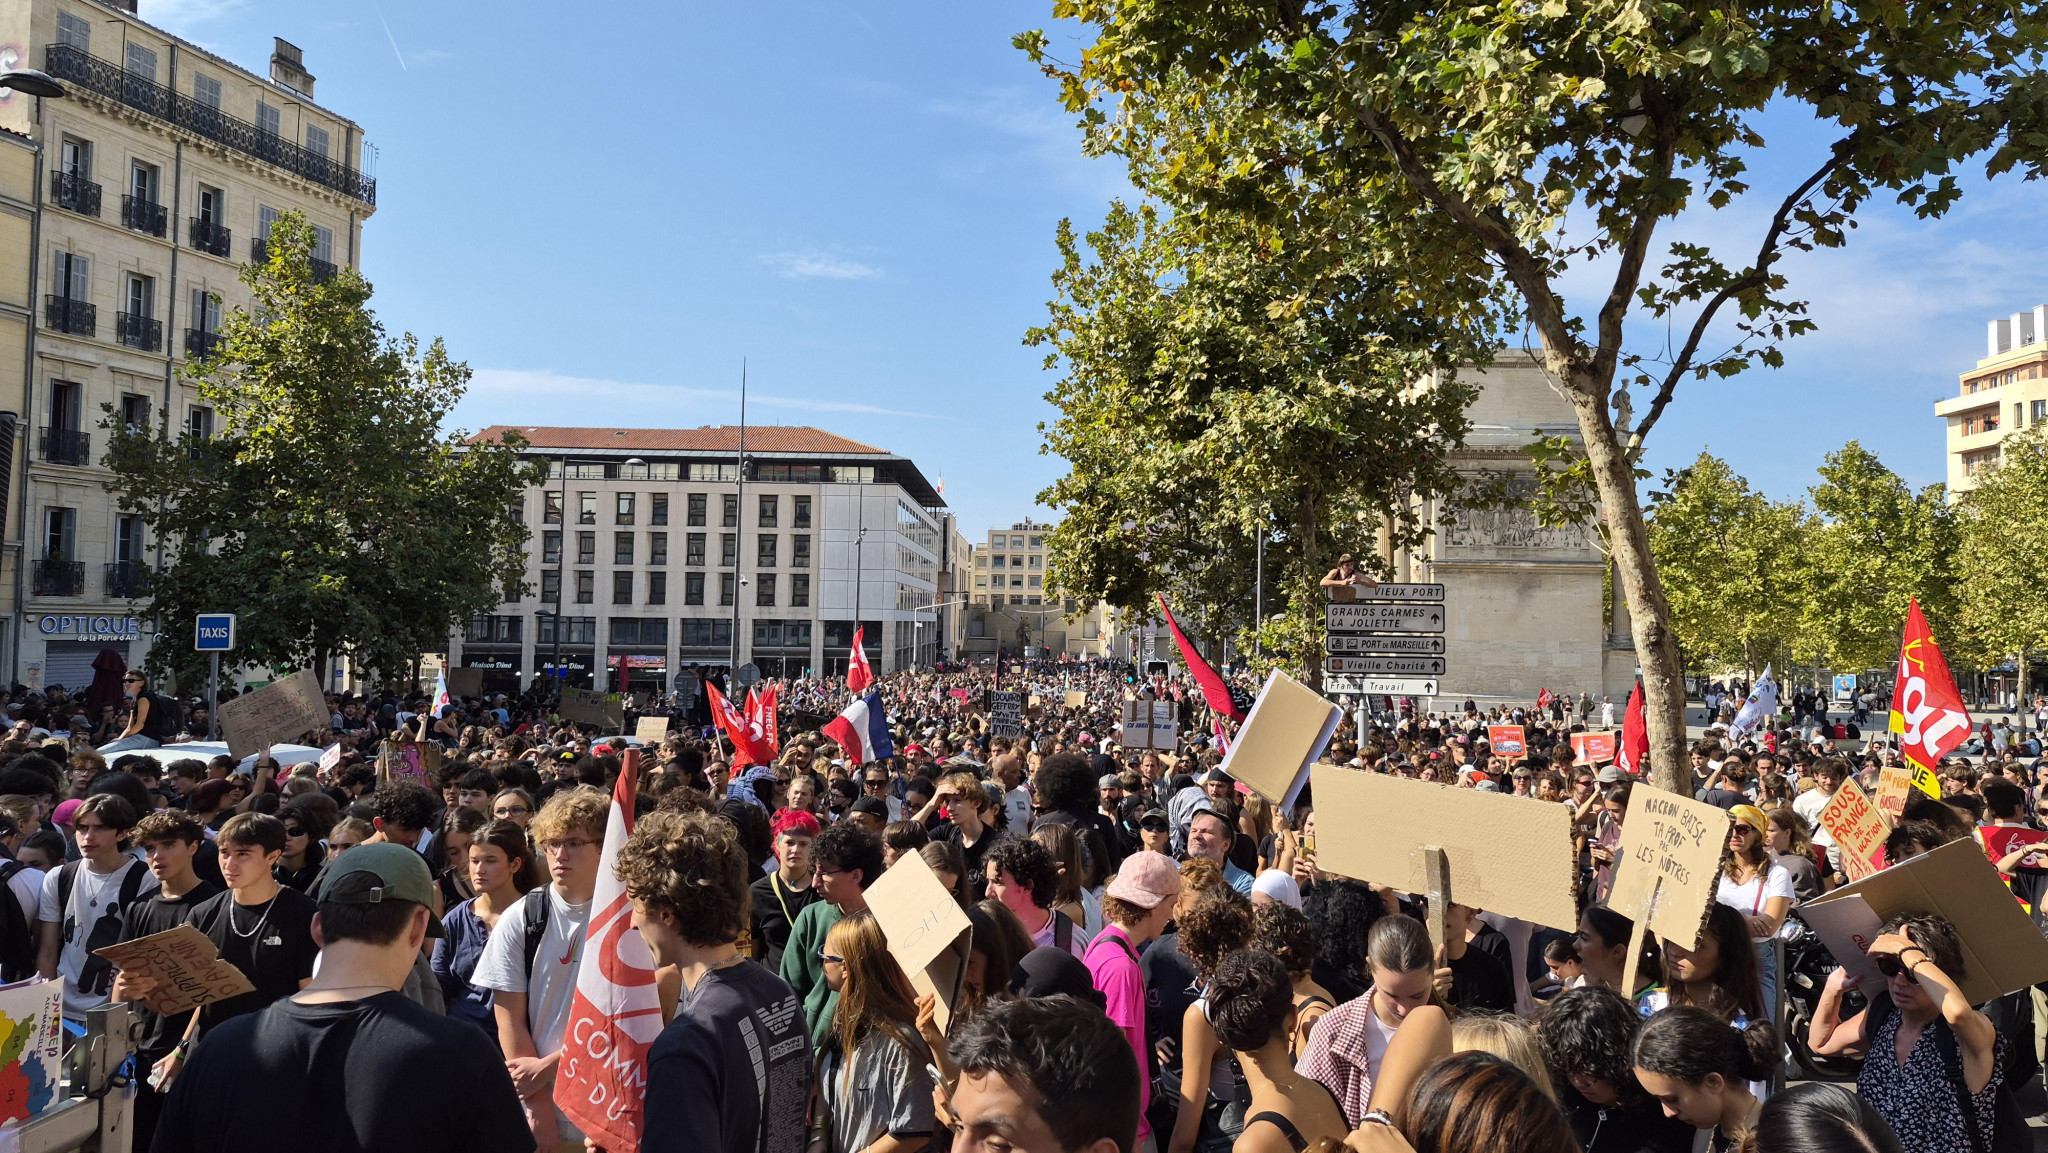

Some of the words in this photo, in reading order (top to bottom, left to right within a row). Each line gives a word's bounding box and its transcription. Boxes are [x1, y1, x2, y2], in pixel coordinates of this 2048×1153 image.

[1374, 587, 1406, 596] VIEUX
[1412, 588, 1441, 597] PORT
[1331, 607, 1375, 616] GRANDS
[1381, 608, 1425, 617] CARMES
[40, 616, 139, 634] OPTIQUE
[1331, 618, 1344, 627] LA
[1350, 619, 1400, 628] JOLIETTE
[78, 634, 88, 642] de
[89, 634, 96, 642] la
[98, 634, 118, 642] Porte
[119, 634, 138, 642] d'Aix
[200, 627, 228, 638] TAXIS
[1361, 640, 1382, 649] PORT
[1390, 640, 1430, 650] MARSEILLE
[470, 661, 495, 669] Maison
[568, 662, 585, 670] Dina
[1347, 660, 1381, 670] Vieille
[1386, 661, 1426, 670] Charité
[1330, 682, 1363, 690] France
[1370, 682, 1404, 691] Travail
[765, 706, 774, 744] FNEC-FP
[1881, 770, 1892, 782] ON
[1878, 786, 1886, 794] LA
[1824, 785, 1856, 828] SOUS
[1880, 794, 1906, 812] BASTILLE
[1645, 798, 1680, 818] MACRON
[1680, 809, 1706, 848] BAISE
[1832, 796, 1869, 845] FRANCE
[1654, 822, 1664, 838] TA
[1666, 826, 1686, 848] PROF
[1854, 826, 1864, 840] DE
[1659, 840, 1670, 852] PAS
[1636, 844, 1654, 864] LES
[1658, 854, 1690, 886] NÔTRES
[1821, 966, 1840, 974] YAM
[574, 1017, 647, 1100] COMM
